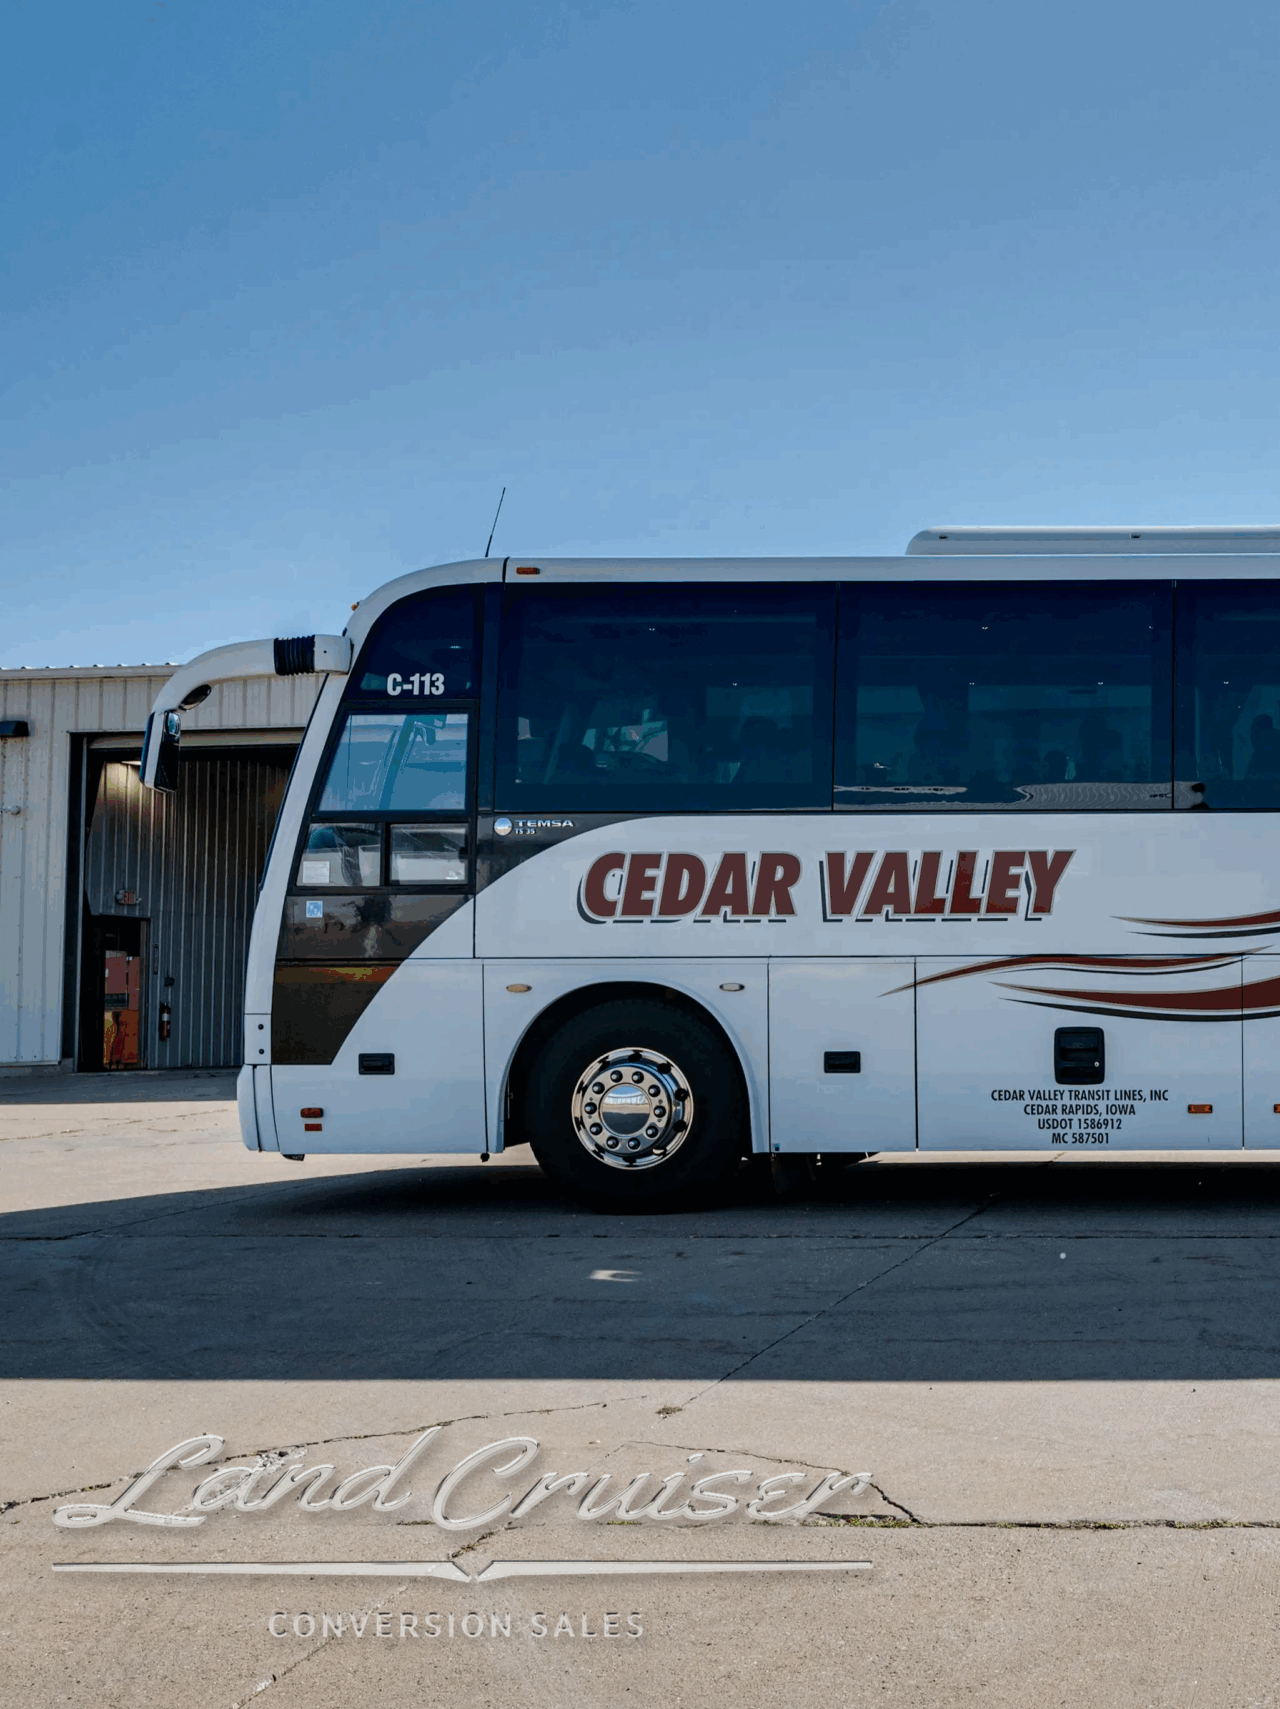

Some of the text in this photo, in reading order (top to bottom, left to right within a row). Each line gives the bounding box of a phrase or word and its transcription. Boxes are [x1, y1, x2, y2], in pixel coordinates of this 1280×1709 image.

[386, 672, 445, 696] C-113
[514, 819, 573, 827] TEMSA
[577, 849, 1076, 924] CEDAR VALLEY
[990, 1089, 1169, 1103] CEDAR VALLEY TRANSIT LINES, INC
[1023, 1104, 1136, 1117] CEDAR RAPIDS, IOWA
[1037, 1118, 1122, 1130] USDOT 1586912
[1051, 1132, 1109, 1144] MC 587501
